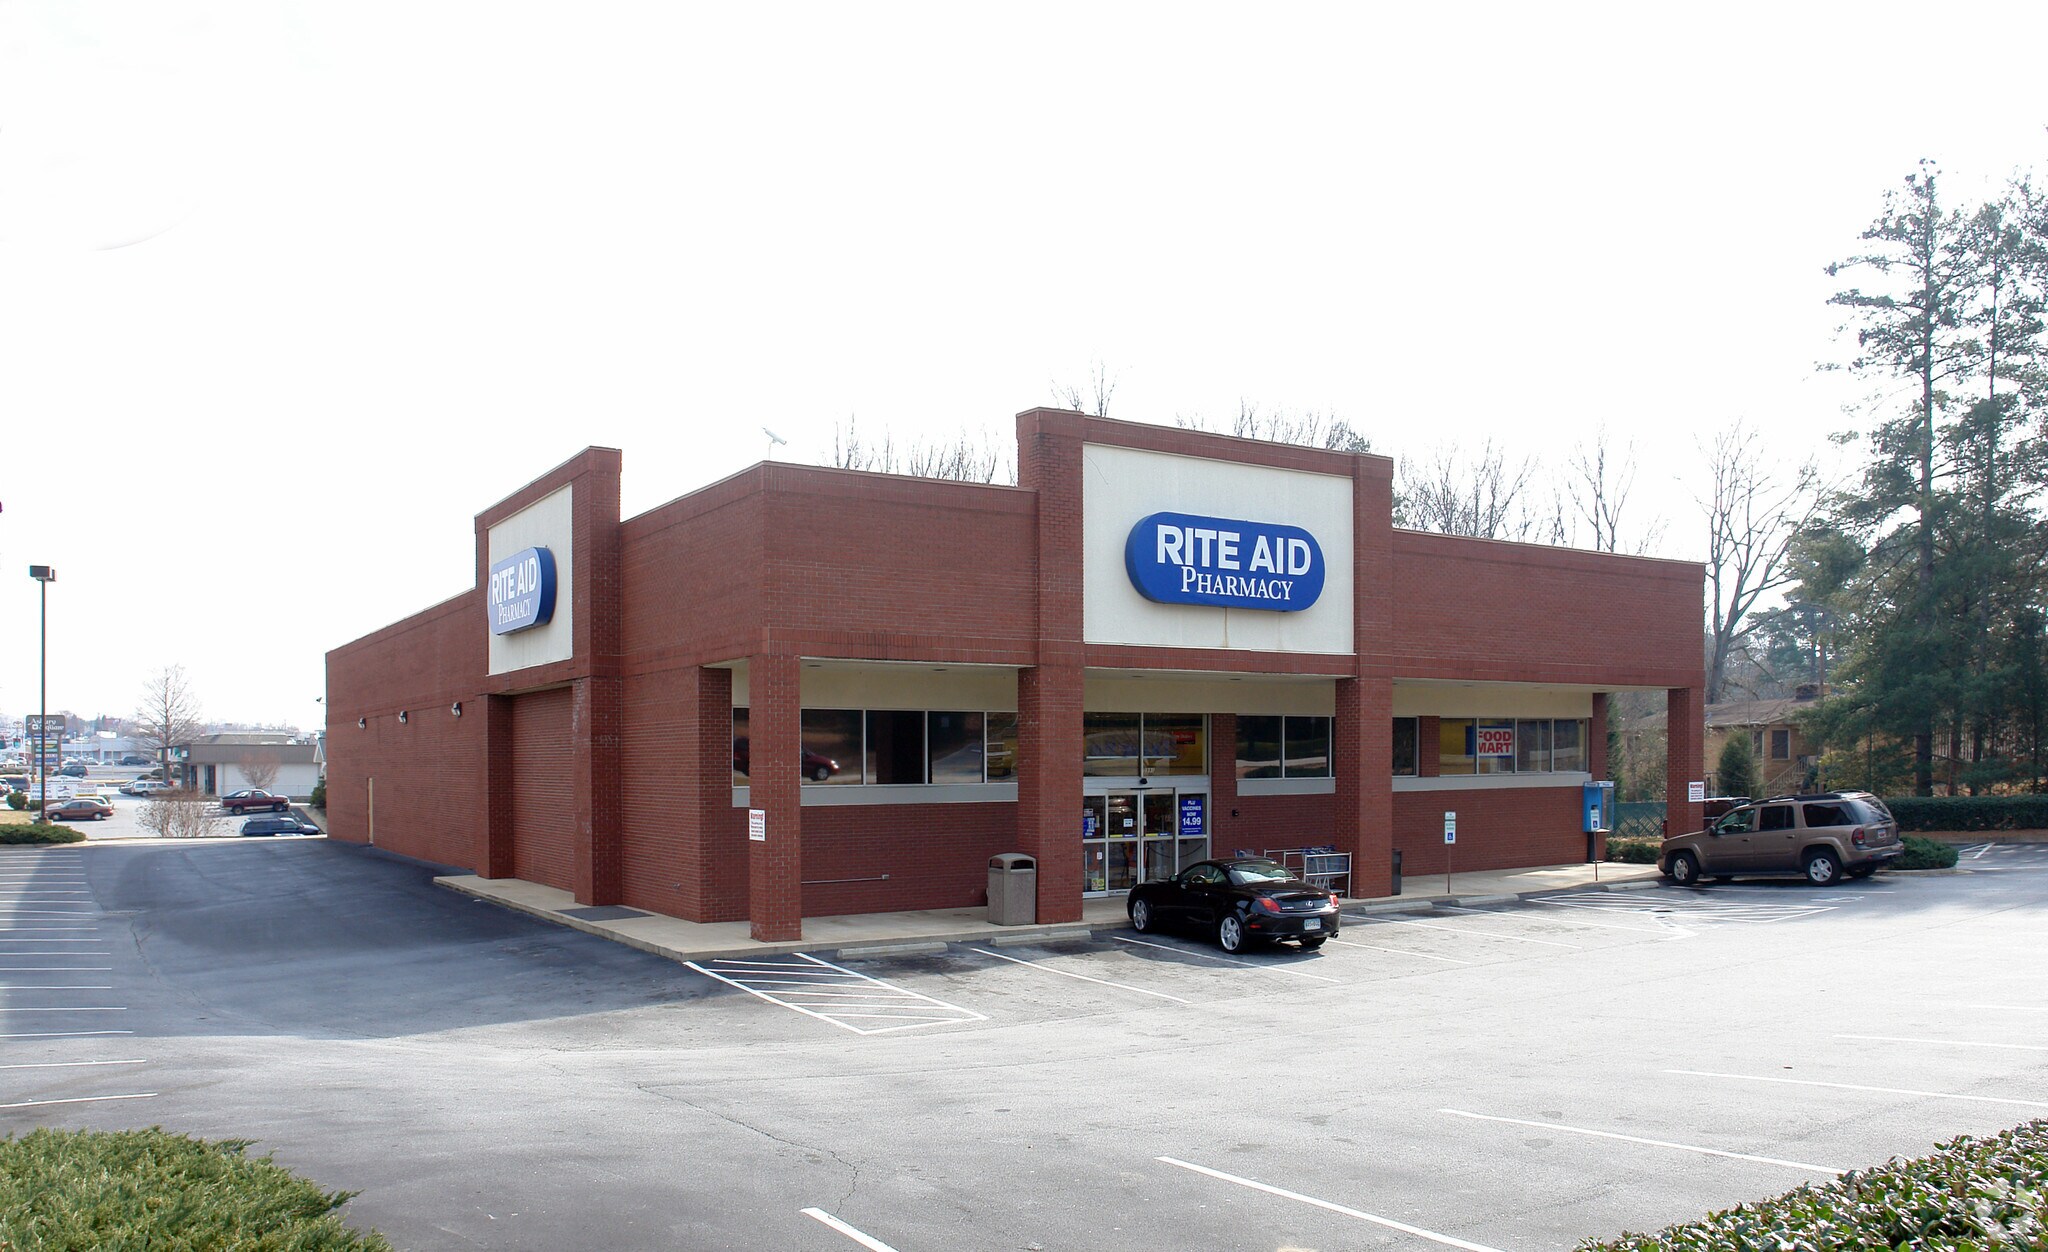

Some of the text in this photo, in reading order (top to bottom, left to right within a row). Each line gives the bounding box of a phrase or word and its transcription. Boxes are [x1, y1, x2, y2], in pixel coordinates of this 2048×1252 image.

[1157, 524, 1311, 576] RITE AID
[492, 557, 537, 605] RITE AID
[1181, 566, 1294, 600] PHARMACY
[498, 598, 531, 625] PHARMACY
[1479, 742, 1511, 753] MART
[1182, 817, 1201, 826] 14.99
